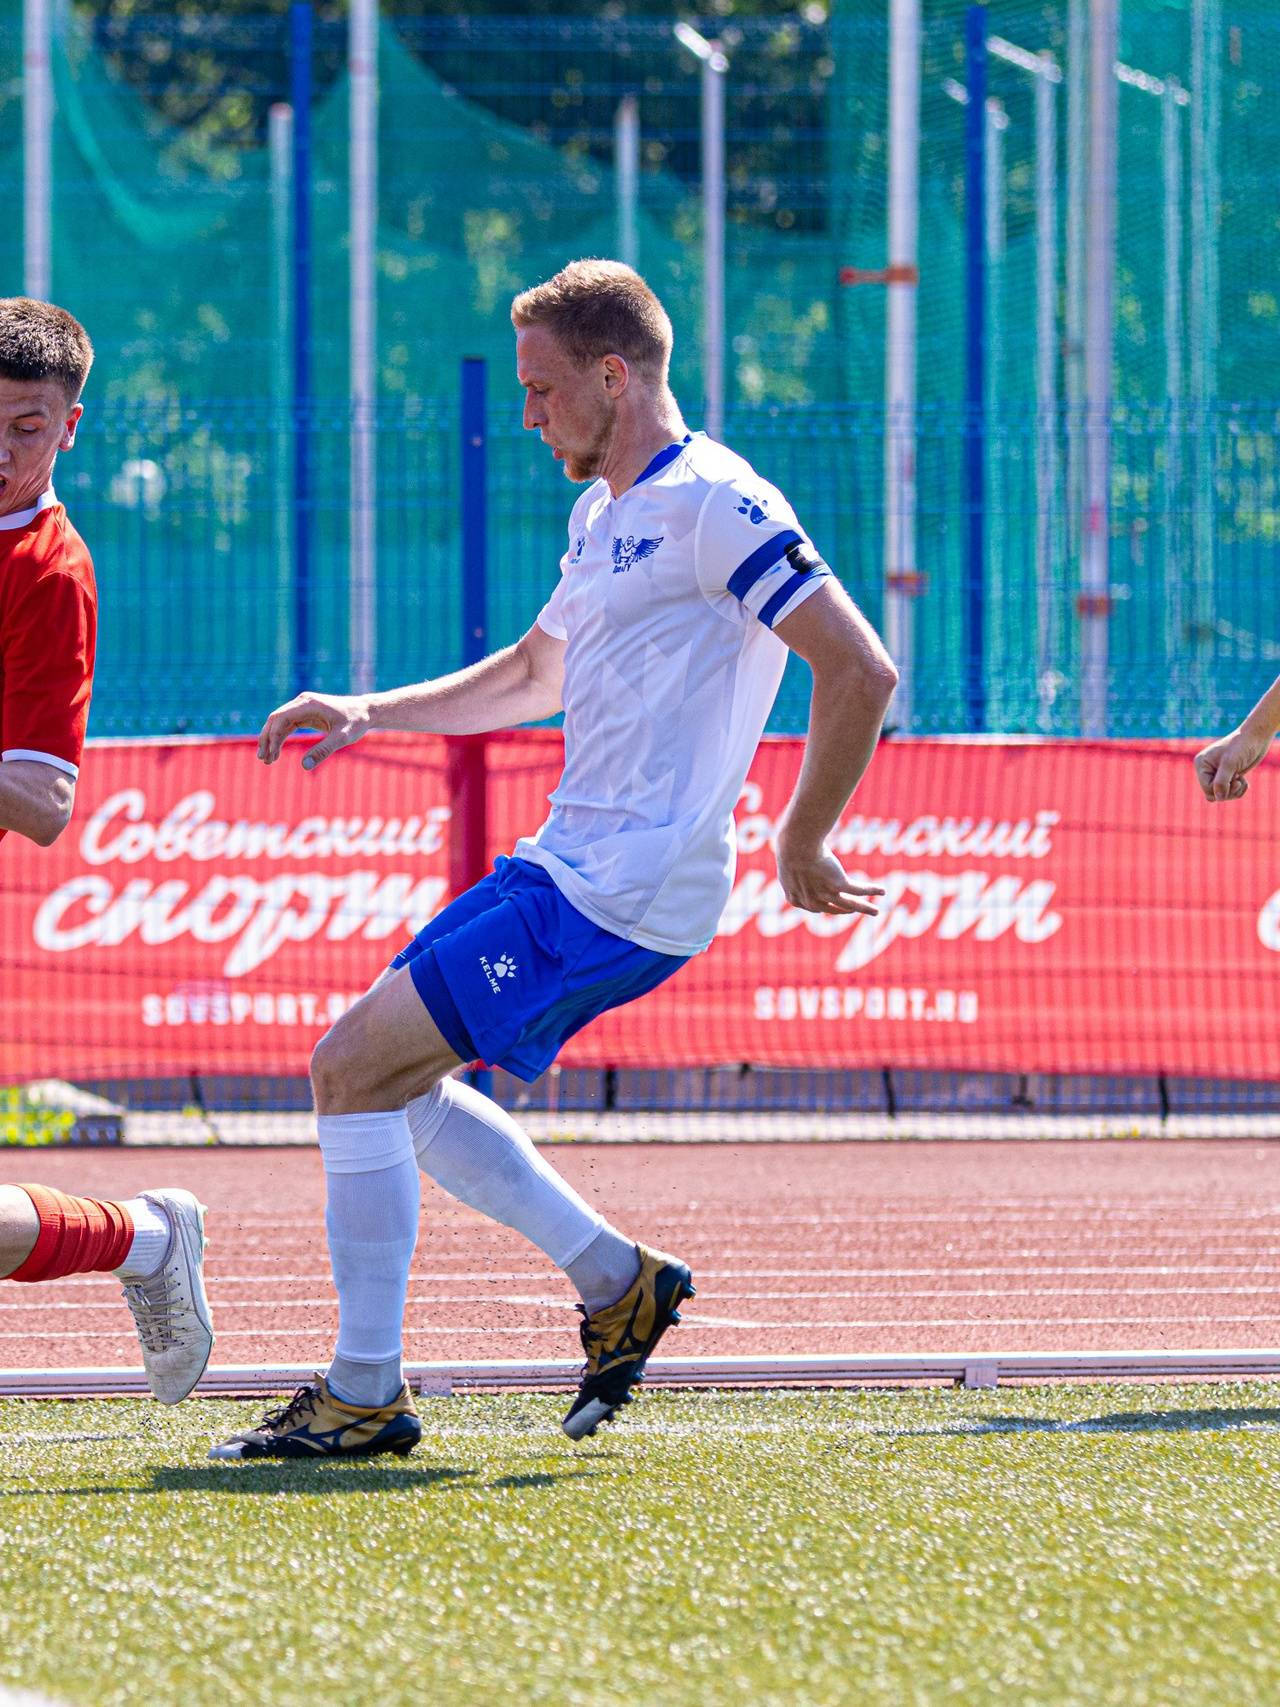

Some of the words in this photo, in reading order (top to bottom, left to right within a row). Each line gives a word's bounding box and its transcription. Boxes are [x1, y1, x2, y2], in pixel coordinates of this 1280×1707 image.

[79, 788, 452, 865] Советский
[479, 955, 501, 994] KELME
[141, 992, 365, 1027] SOVSPORT.R
[754, 986, 979, 1023] SOVSPORT.RU
